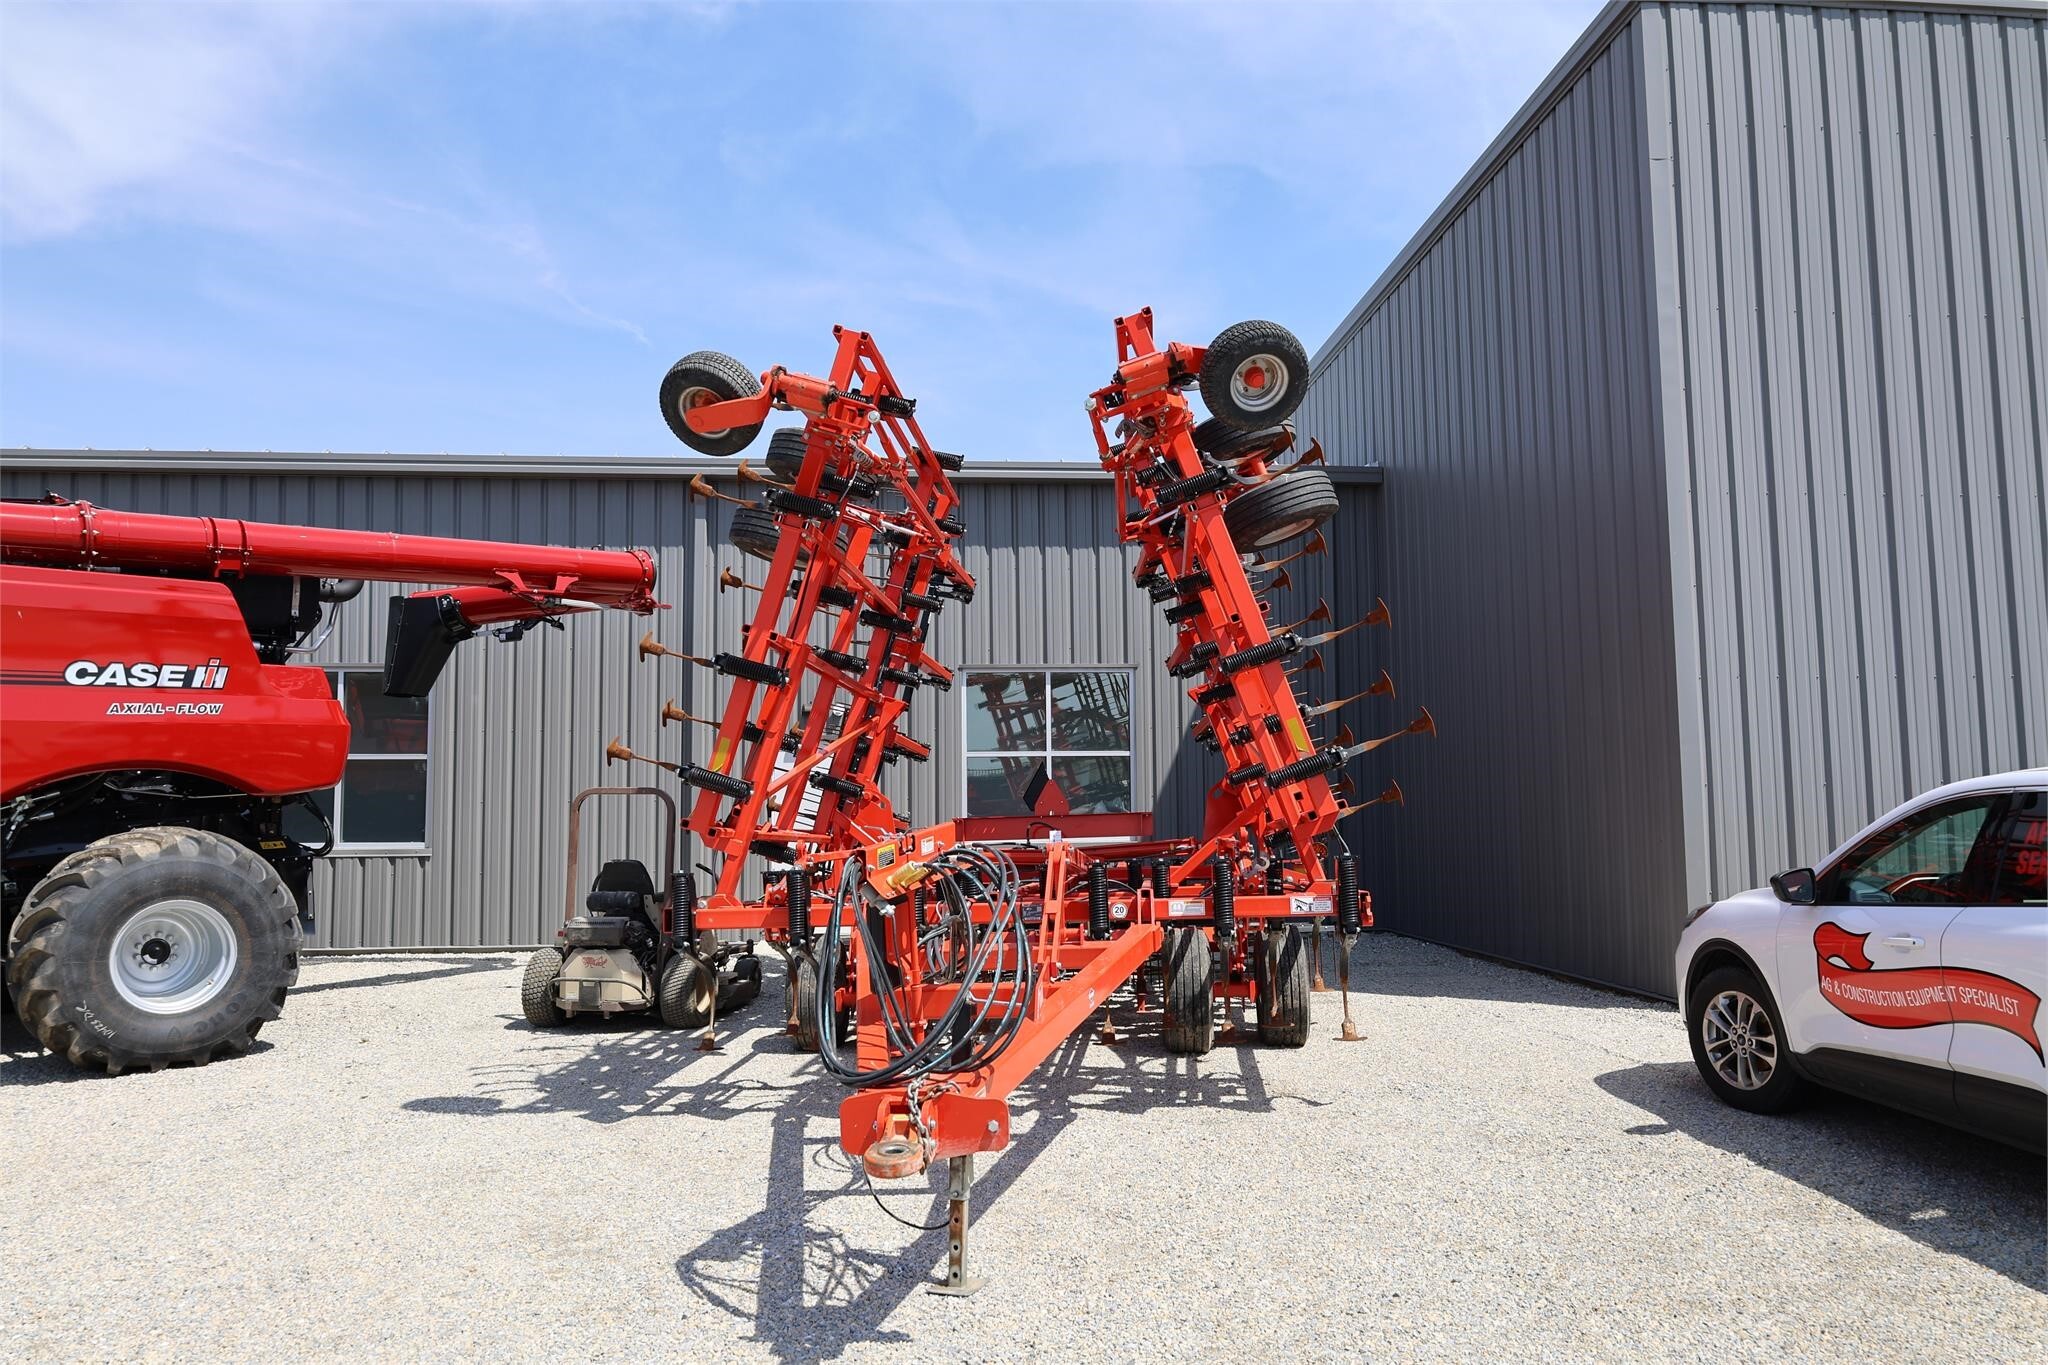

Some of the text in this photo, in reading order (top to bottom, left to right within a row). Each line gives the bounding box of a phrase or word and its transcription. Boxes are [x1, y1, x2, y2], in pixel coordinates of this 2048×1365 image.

[65, 660, 189, 687] CASE
[106, 703, 224, 715] AXIAL-FLOW
[1114, 906, 1125, 914] 20
[1821, 975, 2019, 1017] AG & CONSTRUCTION EQUIPMENT SPECIALIST
